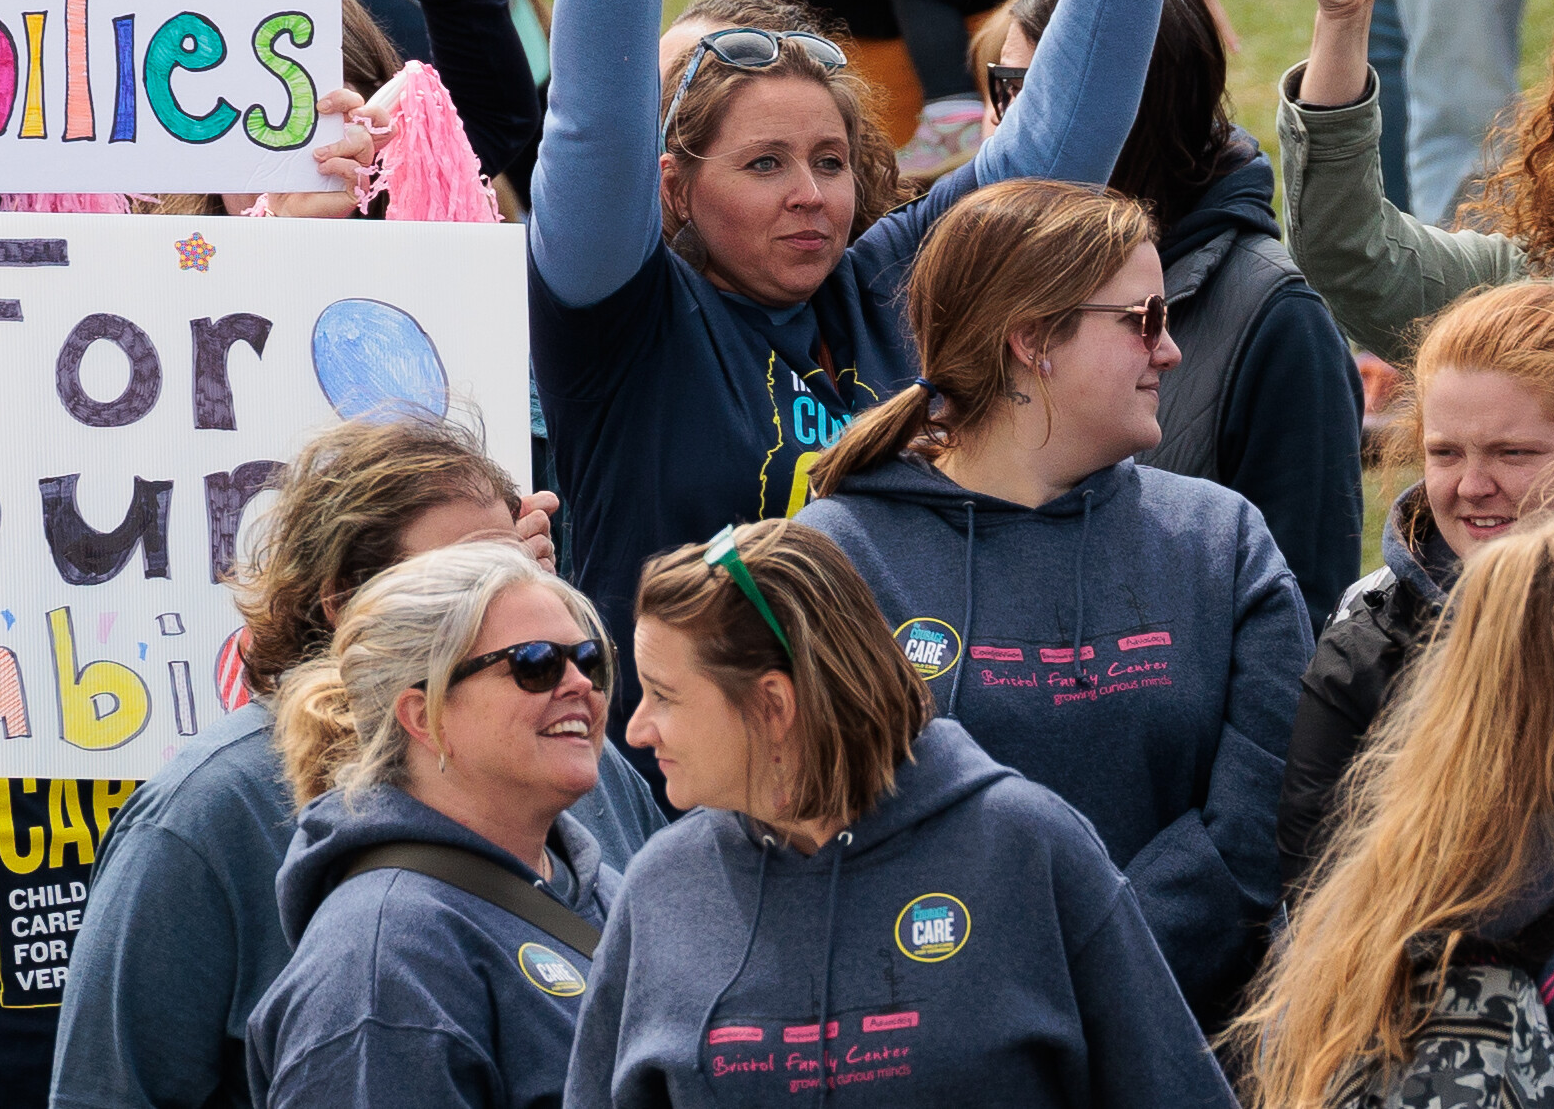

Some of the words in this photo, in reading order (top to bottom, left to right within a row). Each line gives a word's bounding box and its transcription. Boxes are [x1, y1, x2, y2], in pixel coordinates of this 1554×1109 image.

[905, 639, 946, 665] CARE
[981, 669, 1038, 687] Bristol
[1107, 661, 1168, 677] Center
[1053, 689, 1099, 706] growing
[1099, 680, 1139, 696] curious
[1141, 675, 1173, 687] minds
[8, 881, 87, 911] CHILD
[11, 910, 83, 937] CARE
[912, 917, 955, 946] CARE
[13, 940, 68, 965] FOR
[713, 1053, 774, 1077] Bristol
[845, 1044, 910, 1064] Center
